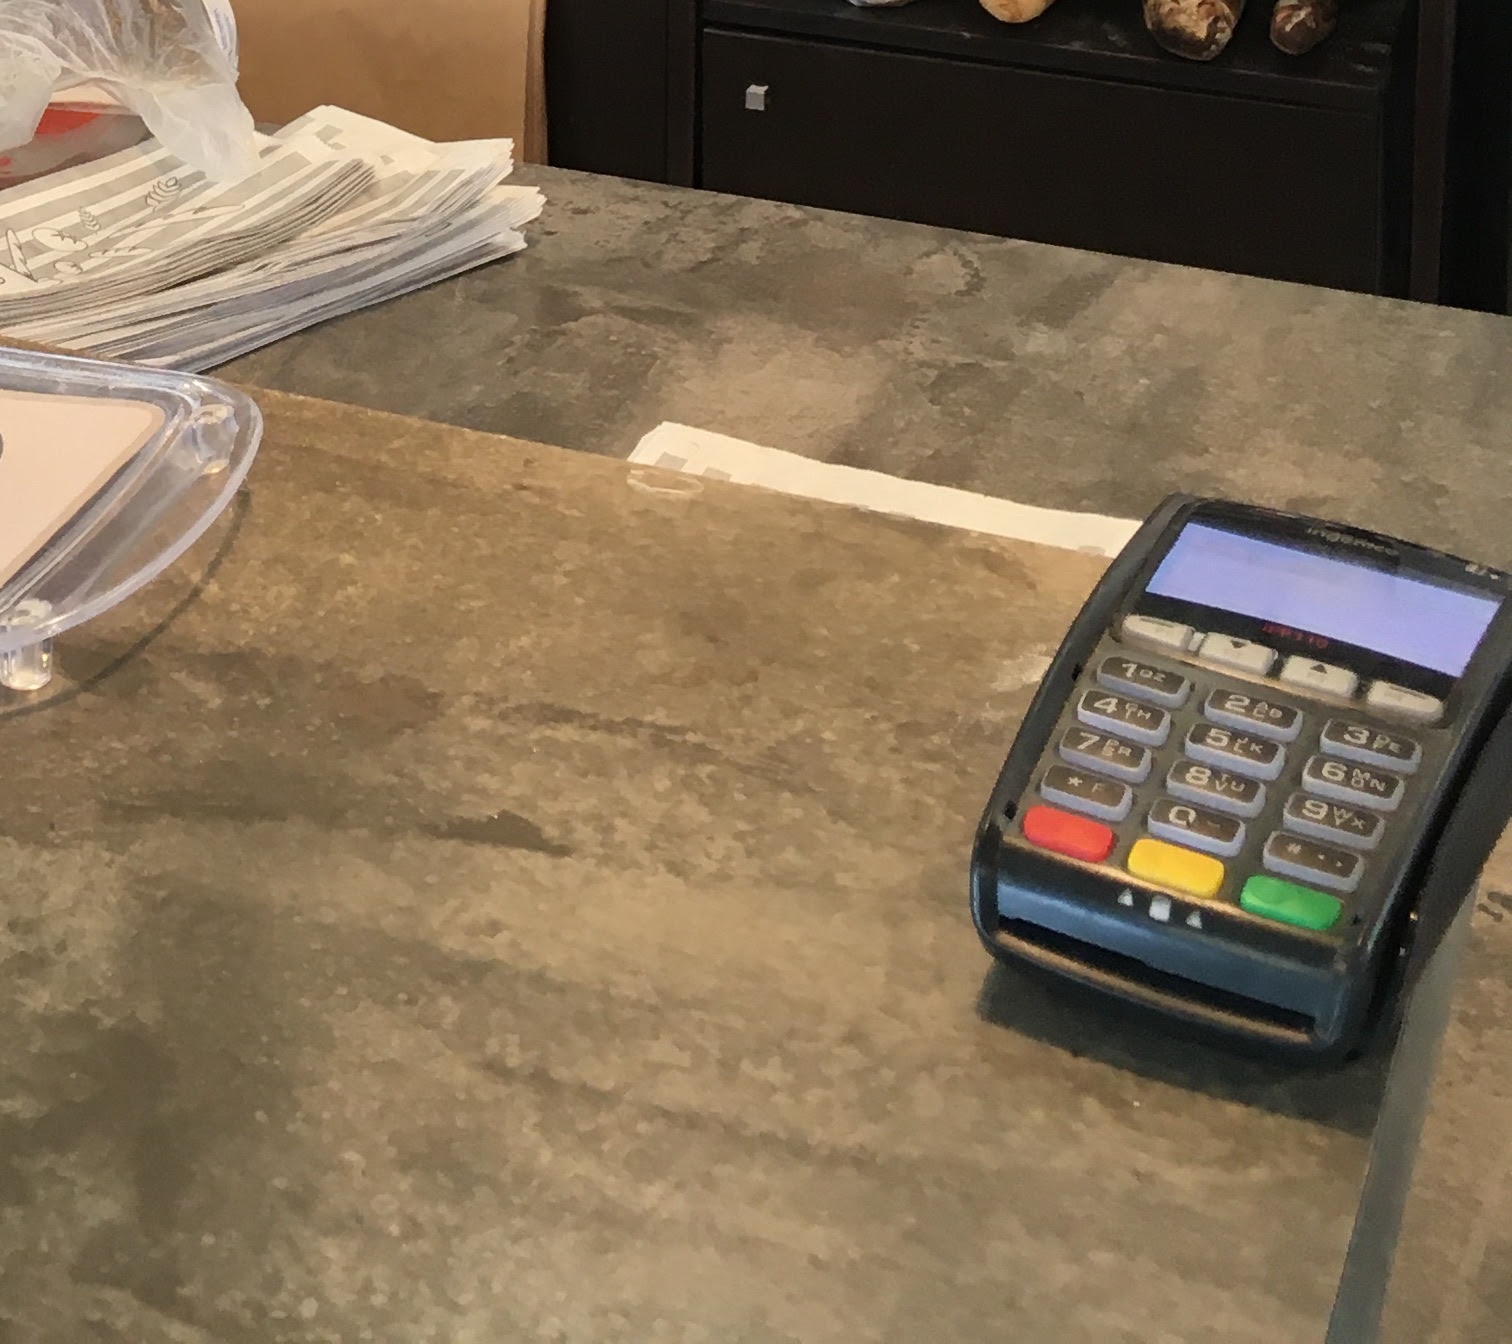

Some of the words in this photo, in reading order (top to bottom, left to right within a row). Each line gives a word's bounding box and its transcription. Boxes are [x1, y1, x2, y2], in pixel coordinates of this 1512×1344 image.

[1094, 696, 1118, 714] 4
[1224, 695, 1251, 713] 2
[1076, 732, 1101, 750] 7
[1205, 729, 1231, 747] 5
[1343, 726, 1370, 744] 3
[1185, 766, 1212, 786] 8
[1321, 763, 1348, 781] 6
[1169, 805, 1197, 825] 0
[1301, 800, 1329, 819] 9
